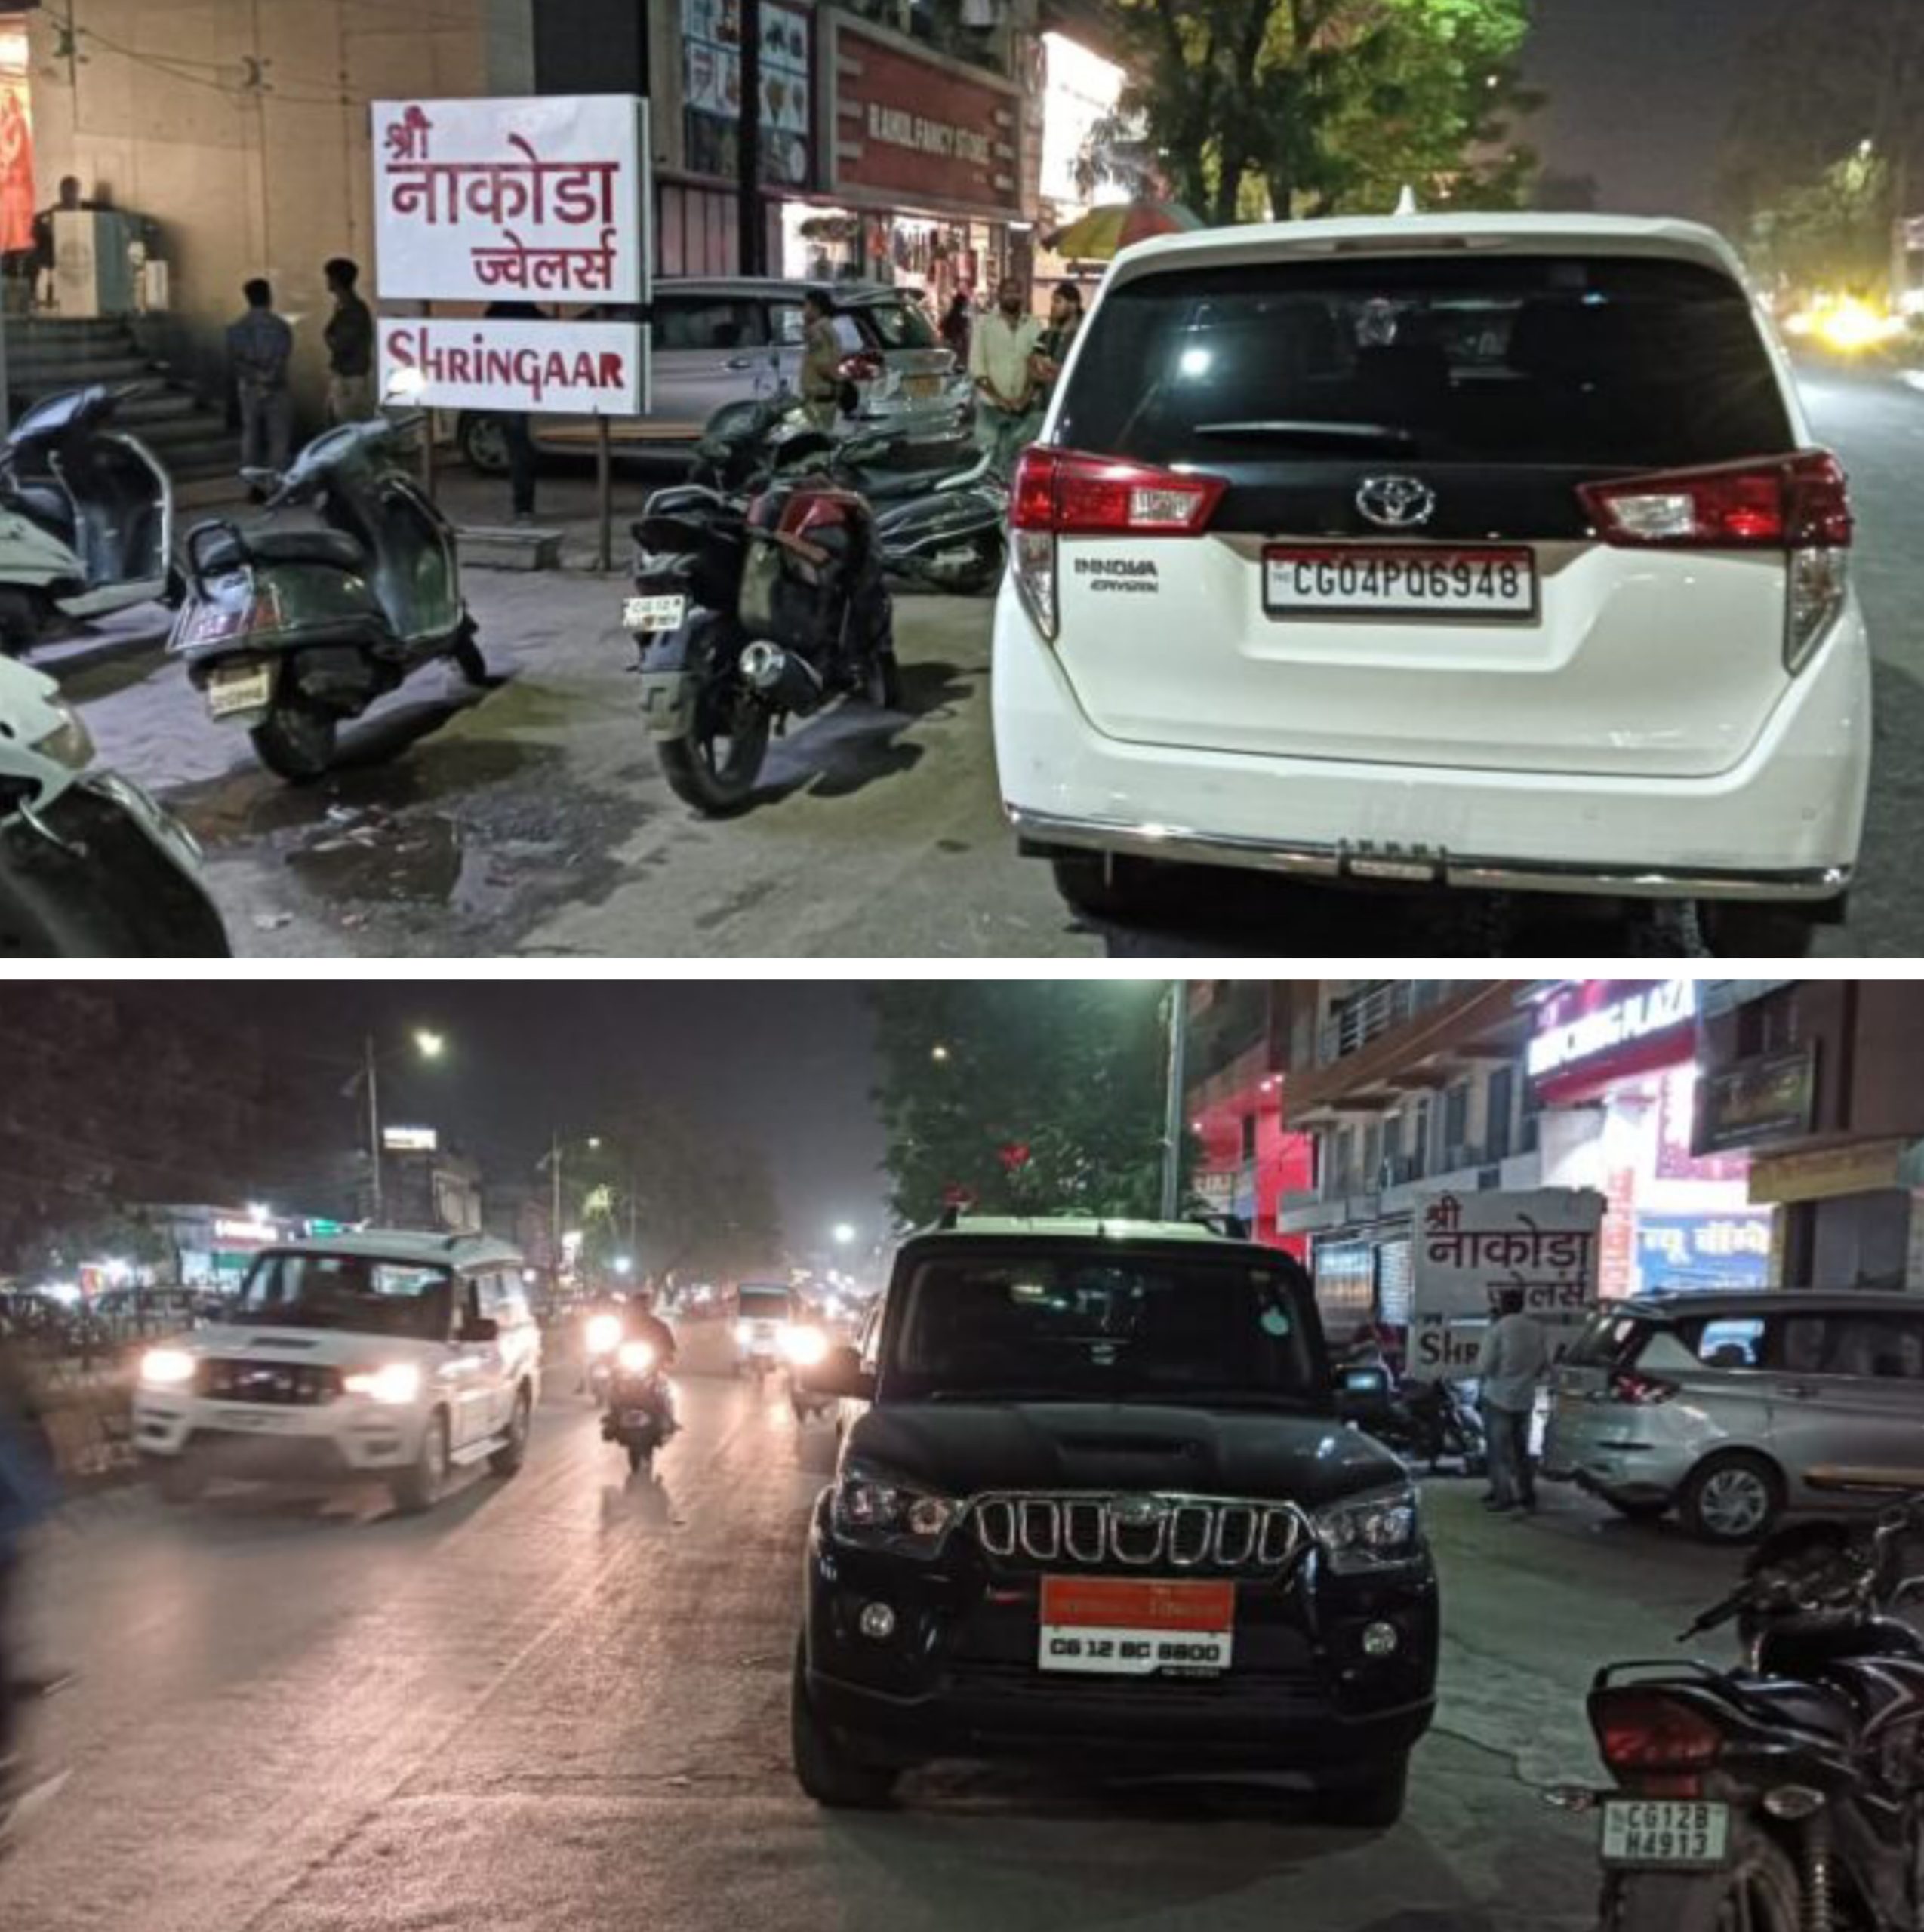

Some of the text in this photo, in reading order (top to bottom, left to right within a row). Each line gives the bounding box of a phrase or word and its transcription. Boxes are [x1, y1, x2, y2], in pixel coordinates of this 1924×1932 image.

[383, 106, 433, 160] श्री
[470, 229, 617, 290] ज्वेलर्स
[1294, 561, 1519, 598] CG04PQ6948
[1424, 1194, 1463, 1231] श्री
[1088, 1640, 1115, 1658] 12
